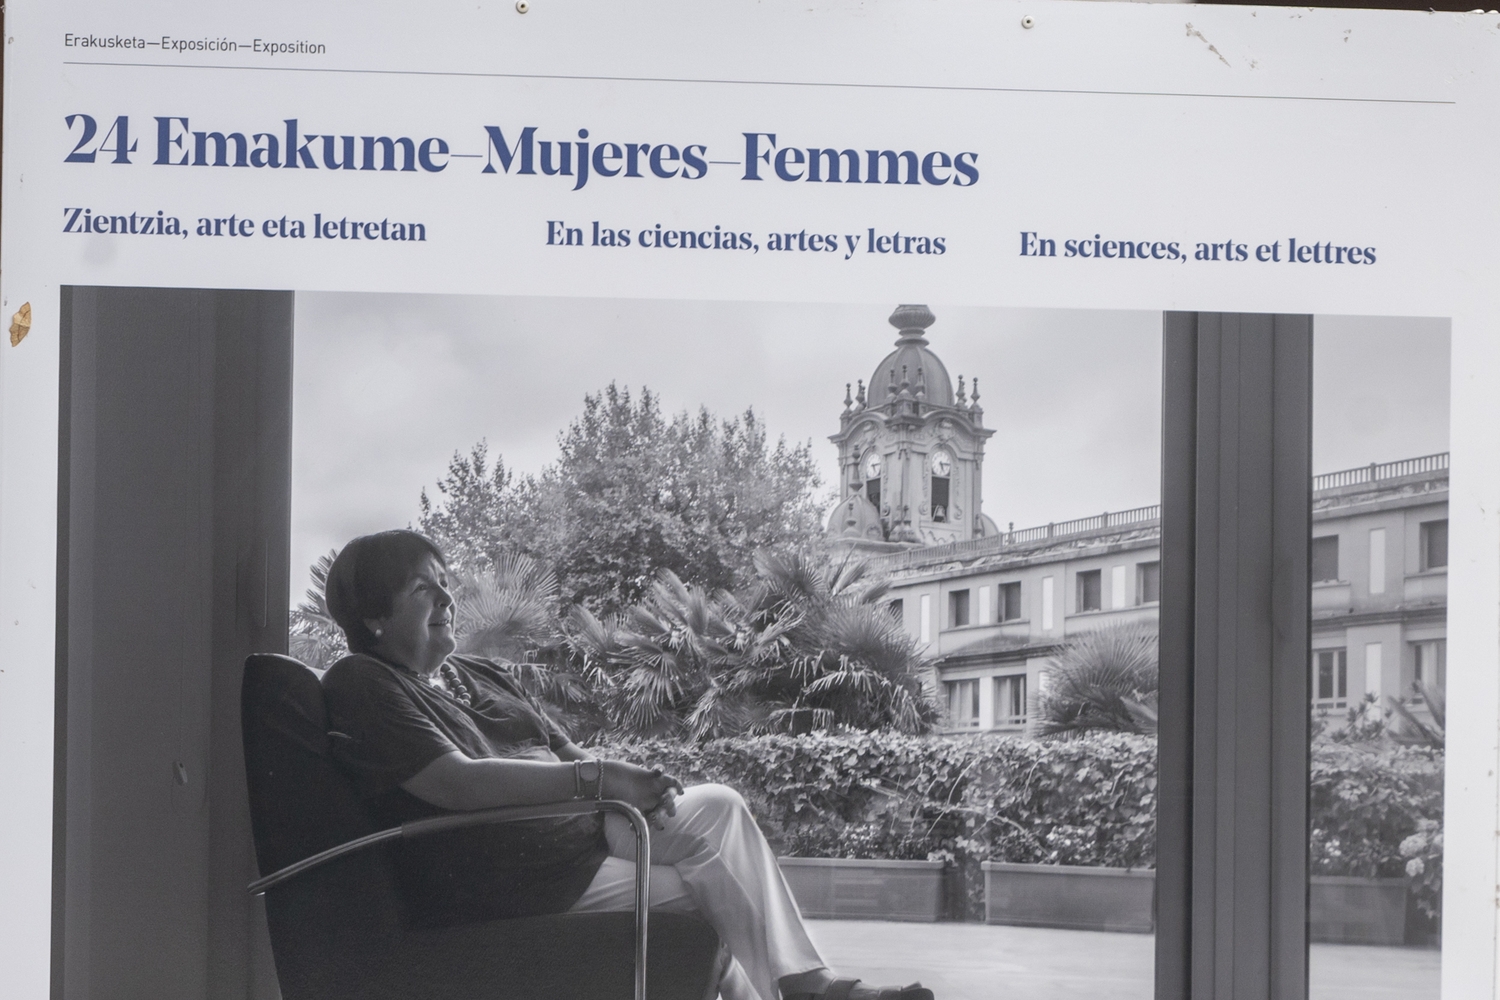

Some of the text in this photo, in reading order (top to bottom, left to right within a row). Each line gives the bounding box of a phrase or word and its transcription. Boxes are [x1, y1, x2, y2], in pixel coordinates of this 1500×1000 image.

[62, 113, 139, 165] 24
[62, 207, 427, 242] Zientzia, arte eta letretan
[545, 220, 947, 261] En las ciencias, artes y letras
[1019, 231, 1377, 266] En sciences, arts et lettres
